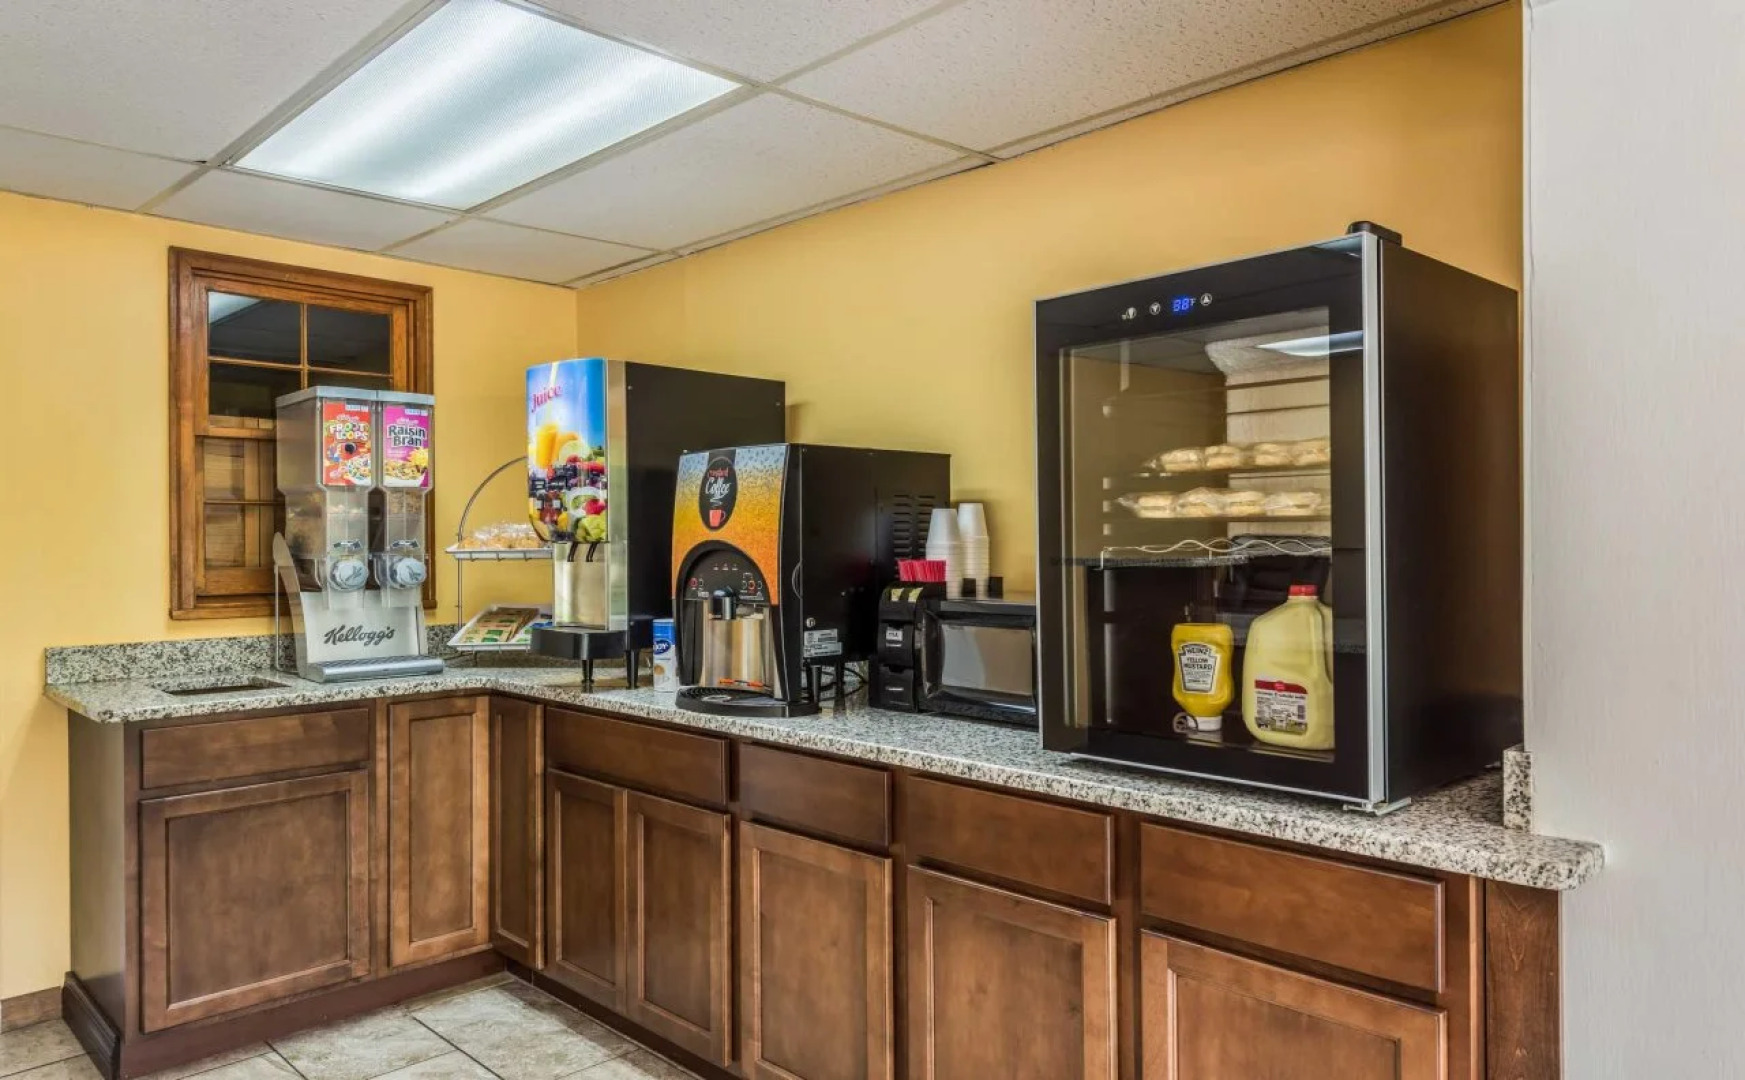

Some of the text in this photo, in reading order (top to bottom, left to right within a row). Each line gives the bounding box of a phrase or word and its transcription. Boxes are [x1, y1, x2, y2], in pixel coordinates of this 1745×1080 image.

[388, 424, 426, 438] Raisin
[391, 435, 422, 447] Bran
[324, 625, 396, 646] Kellogg's
